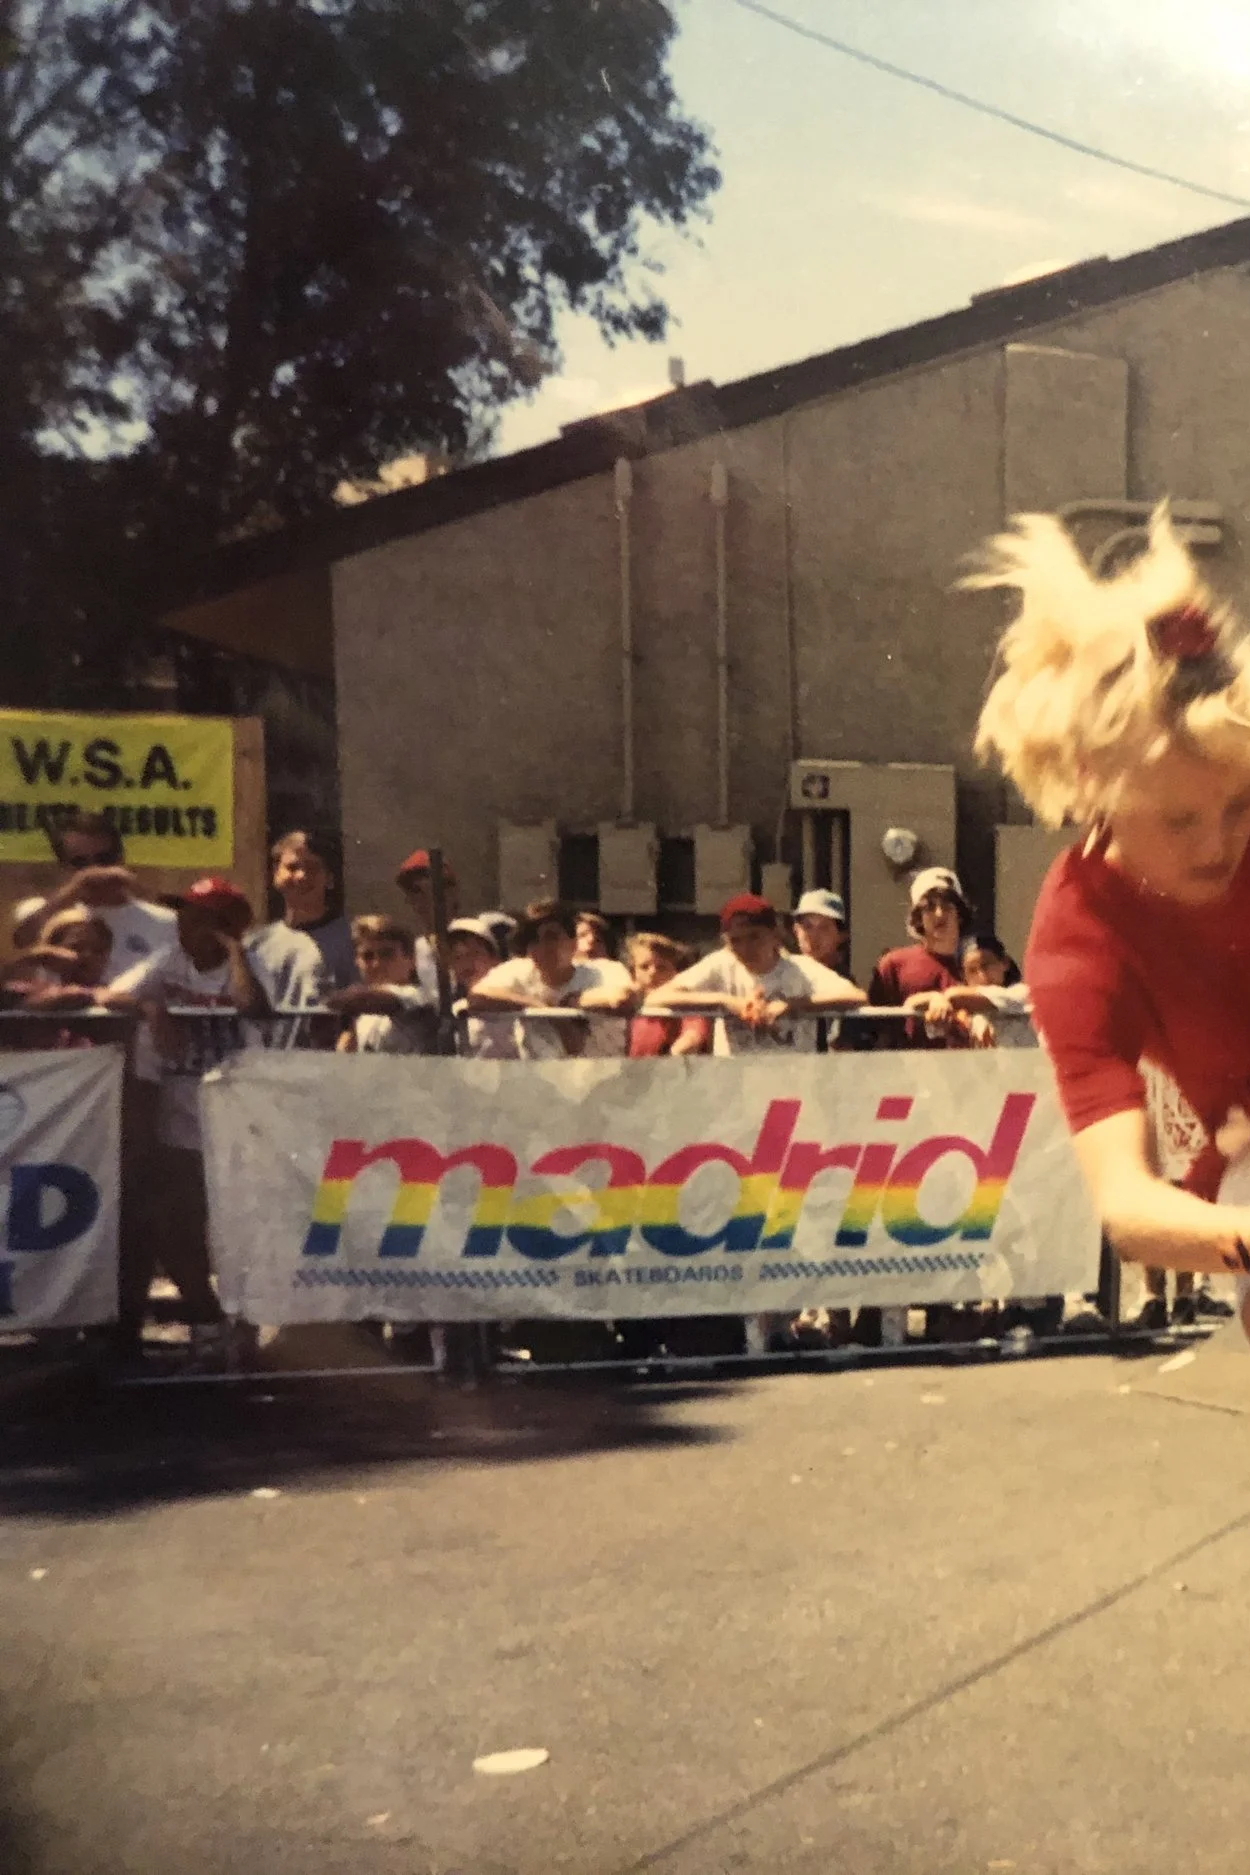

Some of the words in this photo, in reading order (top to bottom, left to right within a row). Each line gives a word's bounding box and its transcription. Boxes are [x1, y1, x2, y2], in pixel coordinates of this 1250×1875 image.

[11, 735, 192, 791] W.S.A.
[302, 1092, 1037, 1260] madrid
[574, 1264, 744, 1287] SKATEBOARDS
